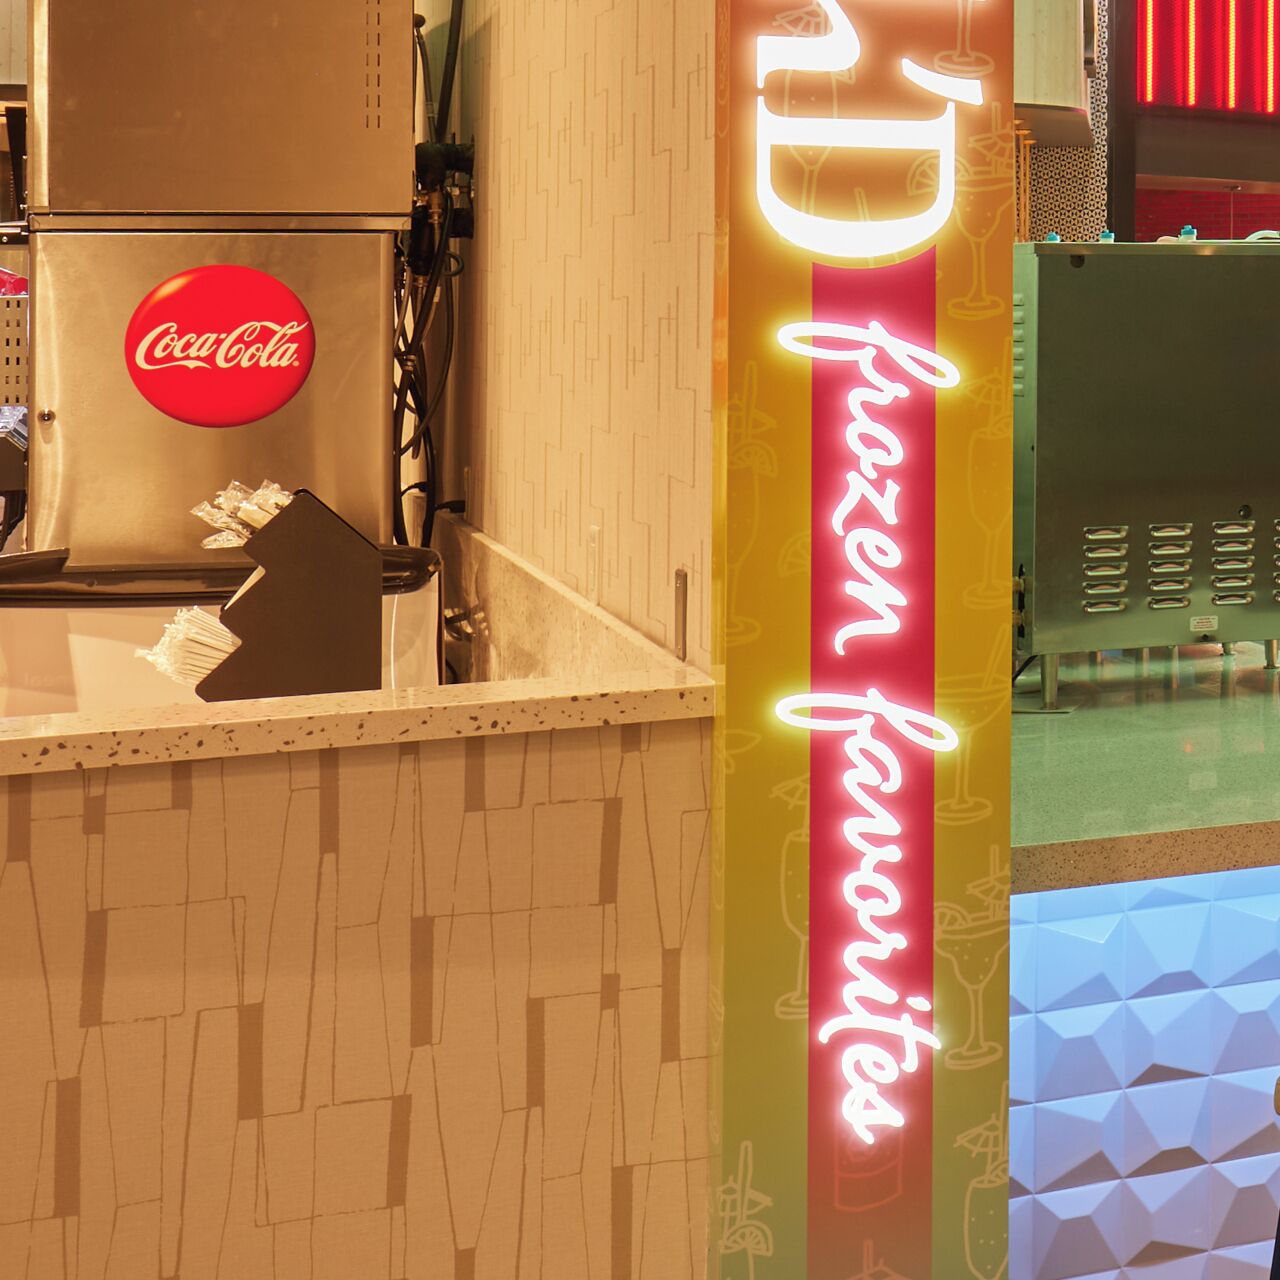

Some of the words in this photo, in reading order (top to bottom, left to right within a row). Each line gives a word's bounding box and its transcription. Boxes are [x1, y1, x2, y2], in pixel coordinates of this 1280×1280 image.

[134, 321, 309, 370] Coca-Cola
[776, 318, 962, 657] frozen
[774, 686, 960, 1146] favorites
